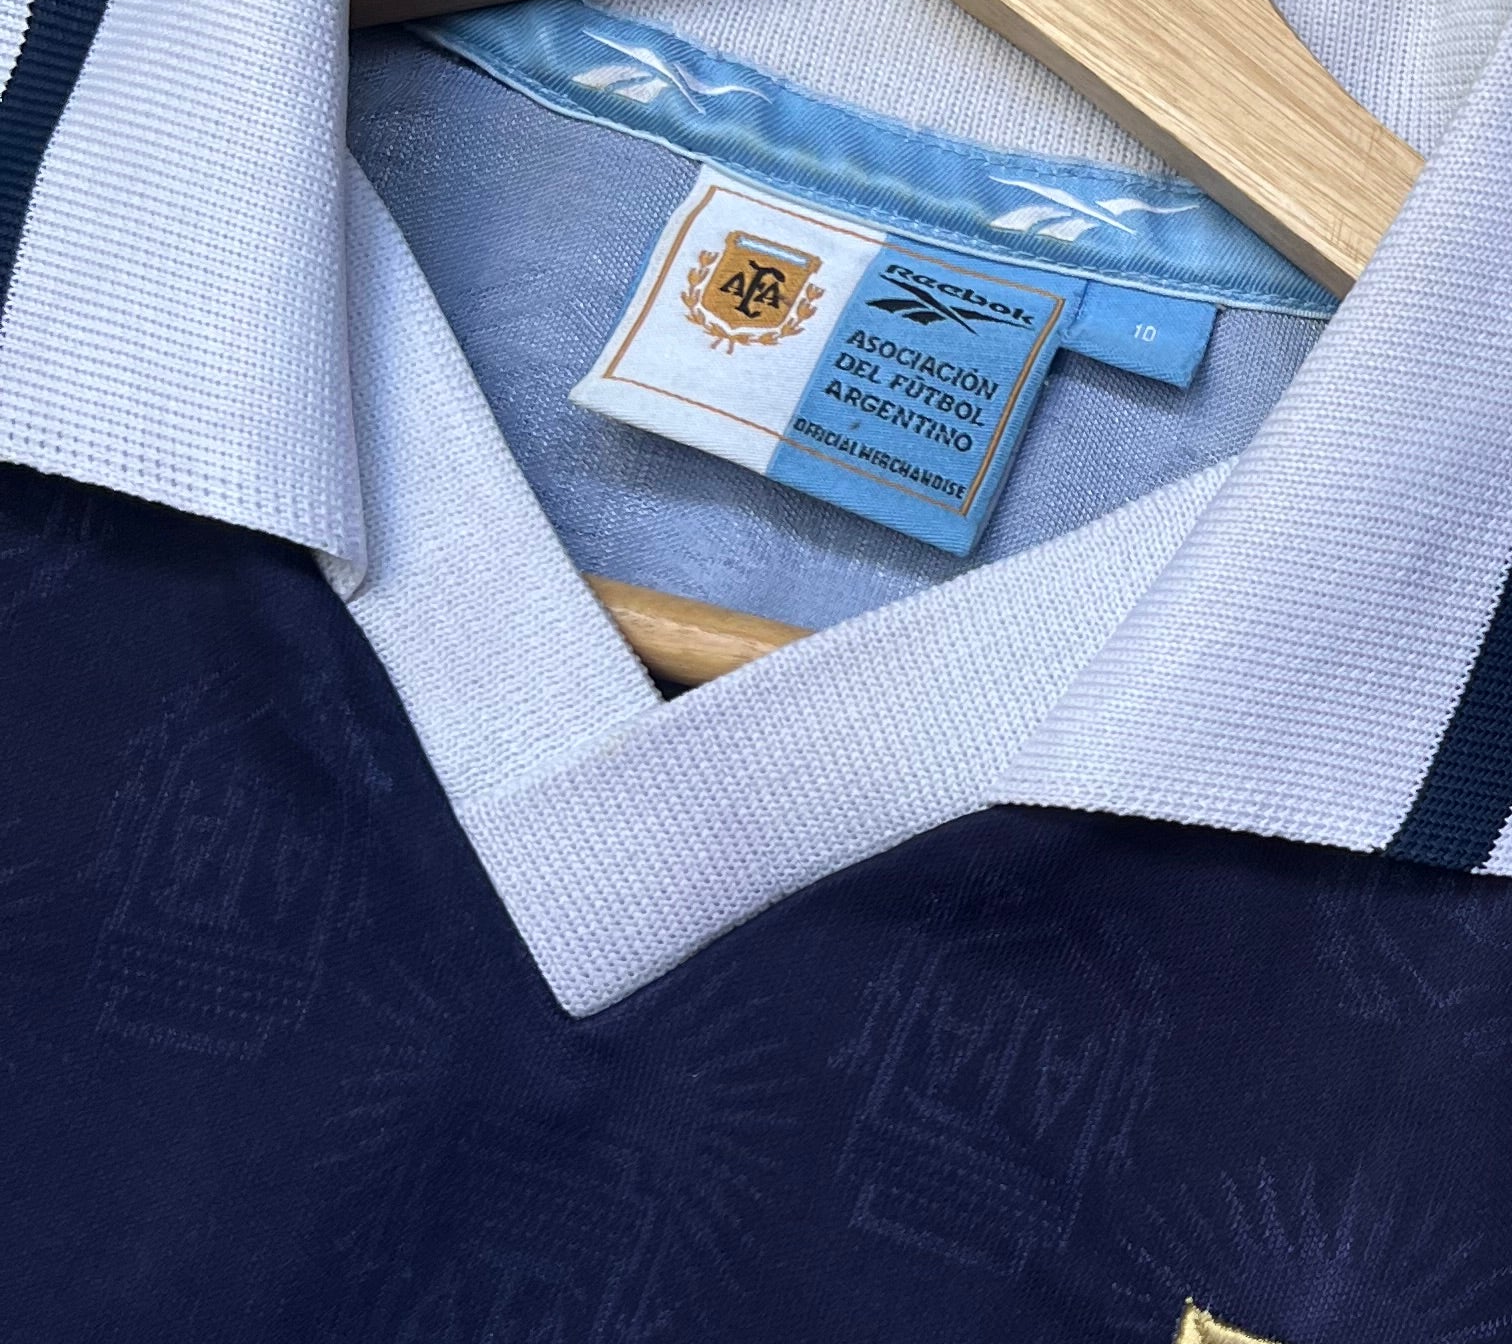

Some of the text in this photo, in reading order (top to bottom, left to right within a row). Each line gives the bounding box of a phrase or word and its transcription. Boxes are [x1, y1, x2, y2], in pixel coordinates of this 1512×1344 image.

[885, 264, 1035, 325] Reebok
[847, 329, 998, 400] ASOCIACIÓN
[1134, 323, 1157, 342] 10
[824, 378, 973, 452] ARGENTINO
[834, 352, 985, 427] DEL FÚTBOL
